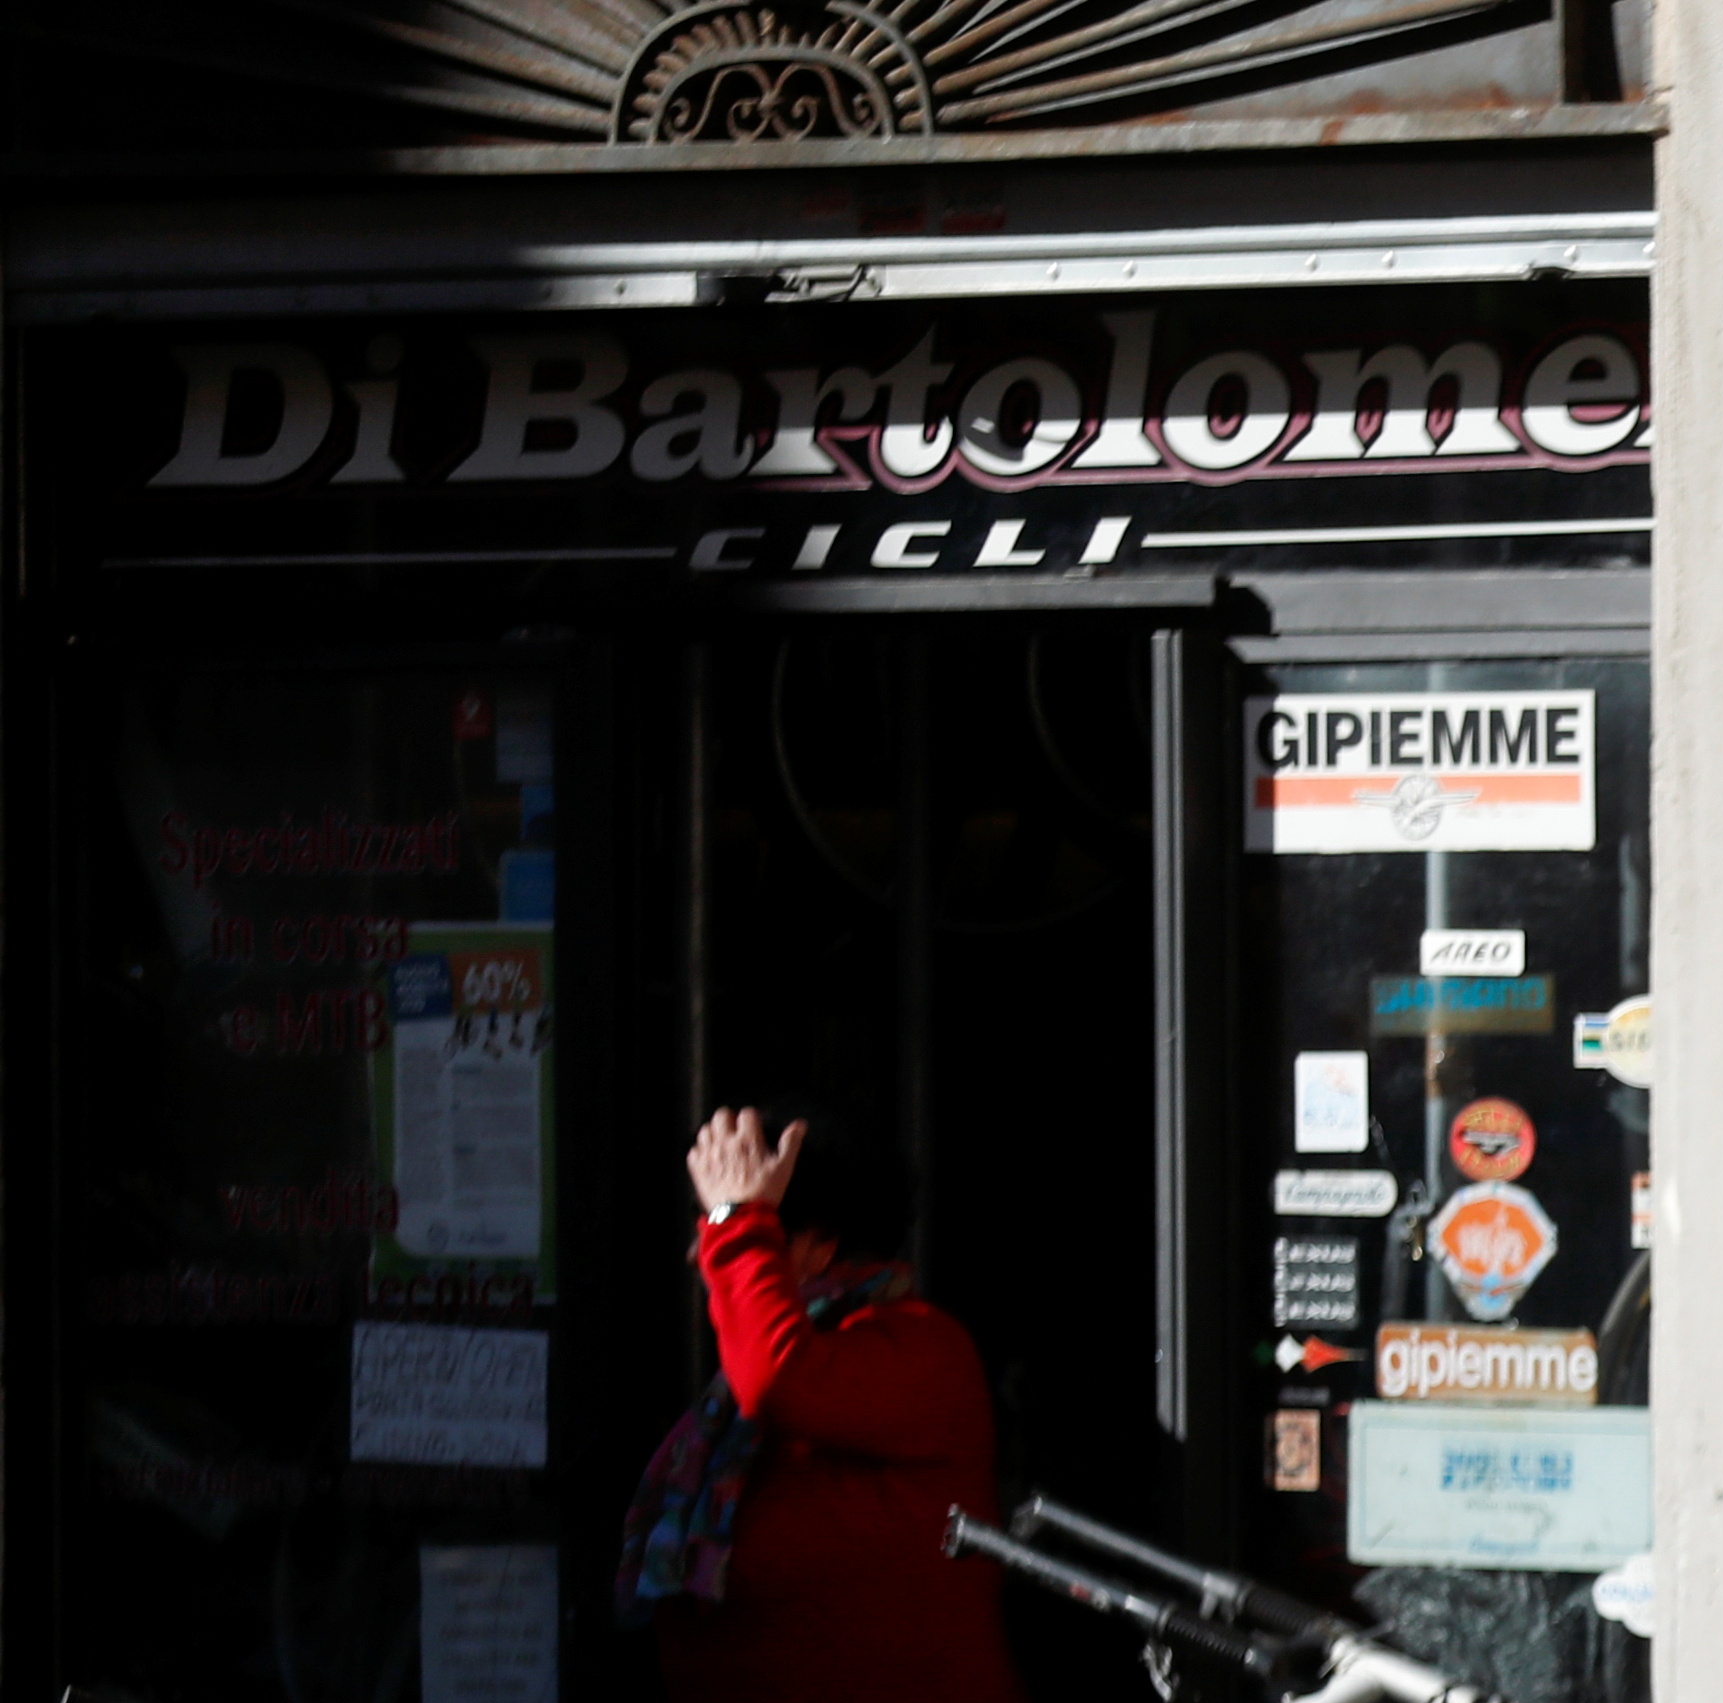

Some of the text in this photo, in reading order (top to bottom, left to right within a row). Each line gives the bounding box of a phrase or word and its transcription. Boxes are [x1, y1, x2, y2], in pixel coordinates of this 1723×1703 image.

[146, 311, 1651, 490] Di Bartolome
[688, 515, 1136, 572] CICLI
[1256, 707, 1581, 768] GIPIEMME
[158, 808, 461, 888] Specializzati
[210, 898, 410, 962] in corsa
[462, 959, 531, 1004] 60%
[232, 1003, 258, 1054] e
[275, 988, 388, 1053] MTB
[218, 1169, 401, 1234] vendita
[359, 1261, 534, 1322] tecnica
[1380, 1331, 1598, 1398] gipiemme
